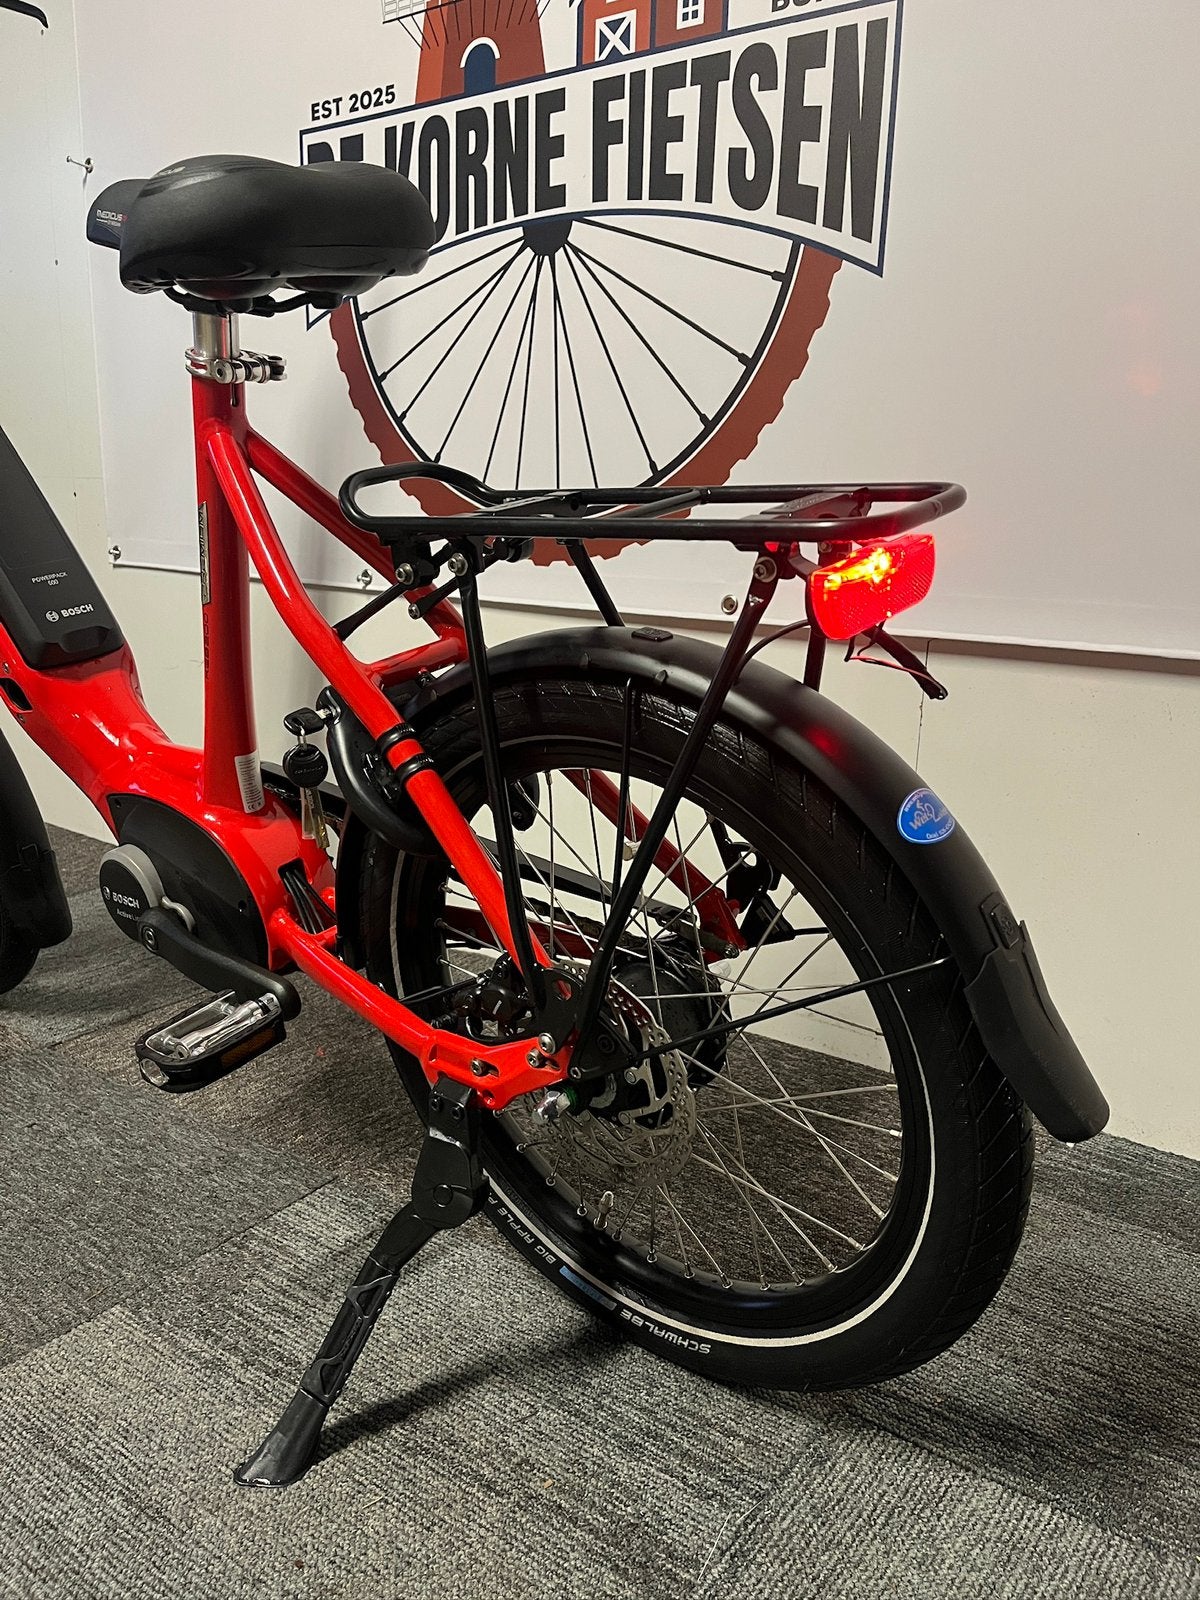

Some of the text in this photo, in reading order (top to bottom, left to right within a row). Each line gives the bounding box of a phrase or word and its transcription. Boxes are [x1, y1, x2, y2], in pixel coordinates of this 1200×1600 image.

[311, 84, 395, 121] EST 2025
[592, 17, 889, 244] FIETSEN
[32, 572, 68, 583] POWERPACK
[61, 603, 94, 618] BOSCH
[112, 892, 140, 909] BOSCH
[497, 1207, 535, 1244] APPLE
[534, 1245, 557, 1265] BIG
[620, 1309, 712, 1355] SCHWALBE
